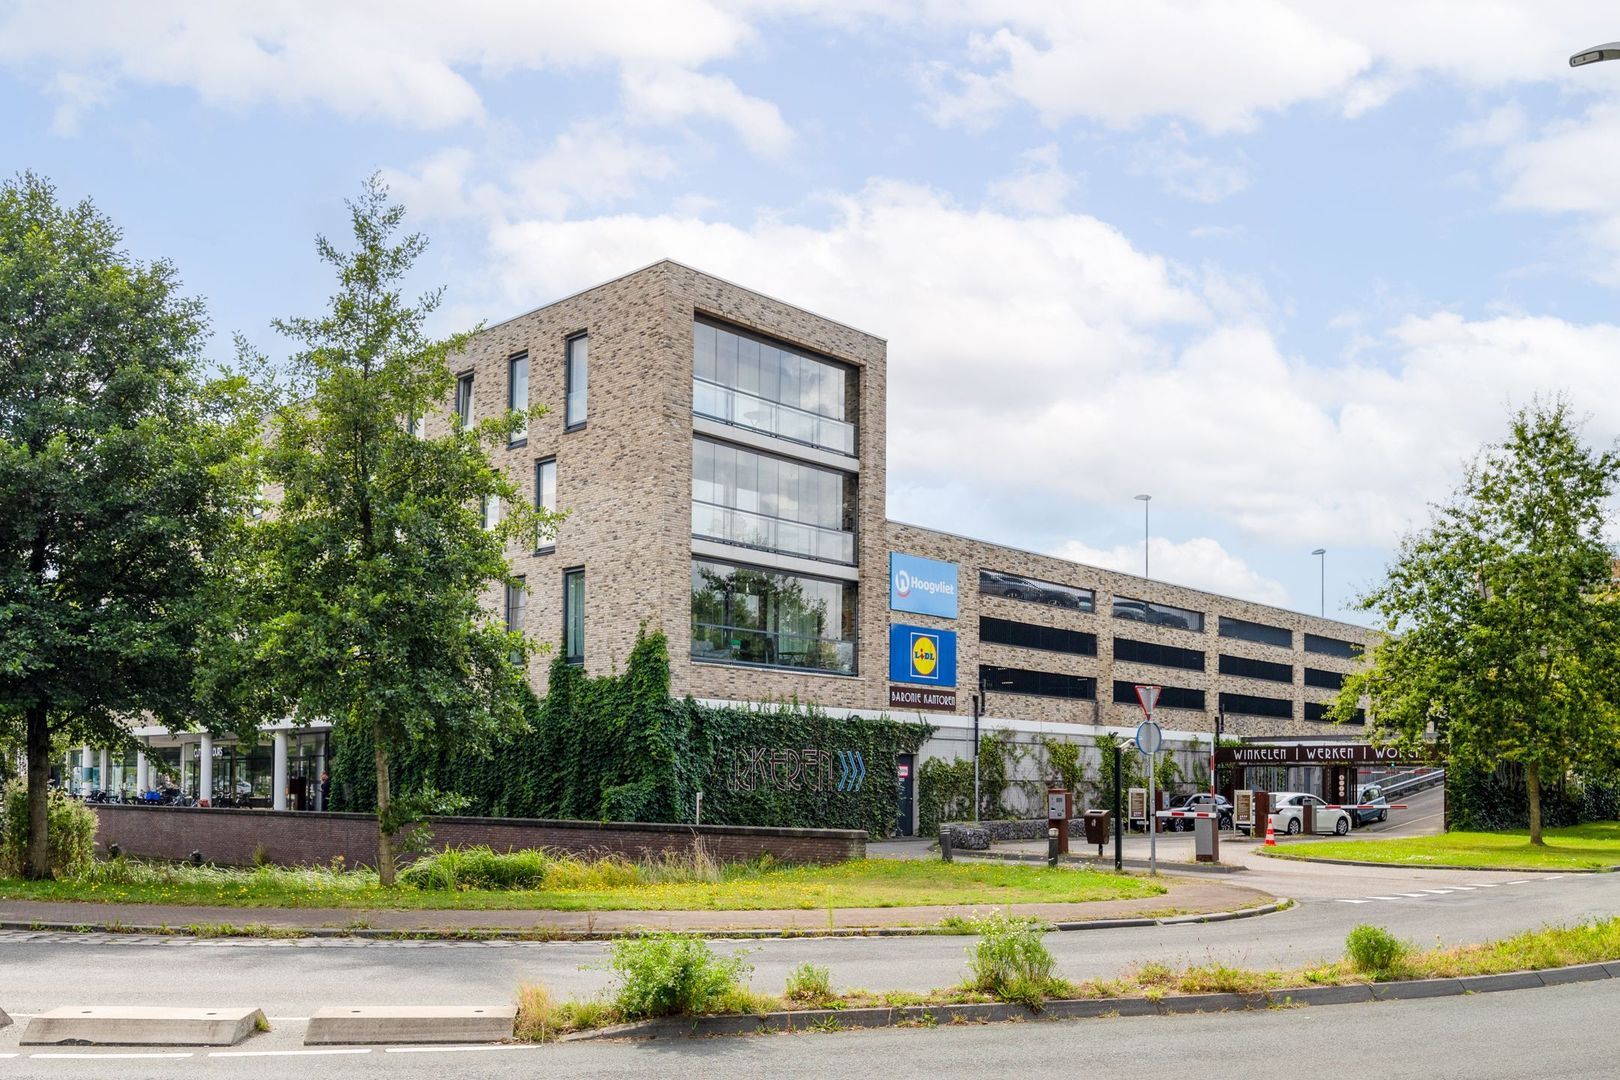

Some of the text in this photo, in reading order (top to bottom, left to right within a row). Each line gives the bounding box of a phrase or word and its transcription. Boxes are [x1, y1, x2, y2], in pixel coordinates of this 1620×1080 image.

[911, 576, 955, 595] Hoogvliet
[891, 691, 956, 706] BARONIE KANTOREN
[1233, 749, 1287, 760] WINKELEN
[1306, 747, 1354, 760] WERKEN
